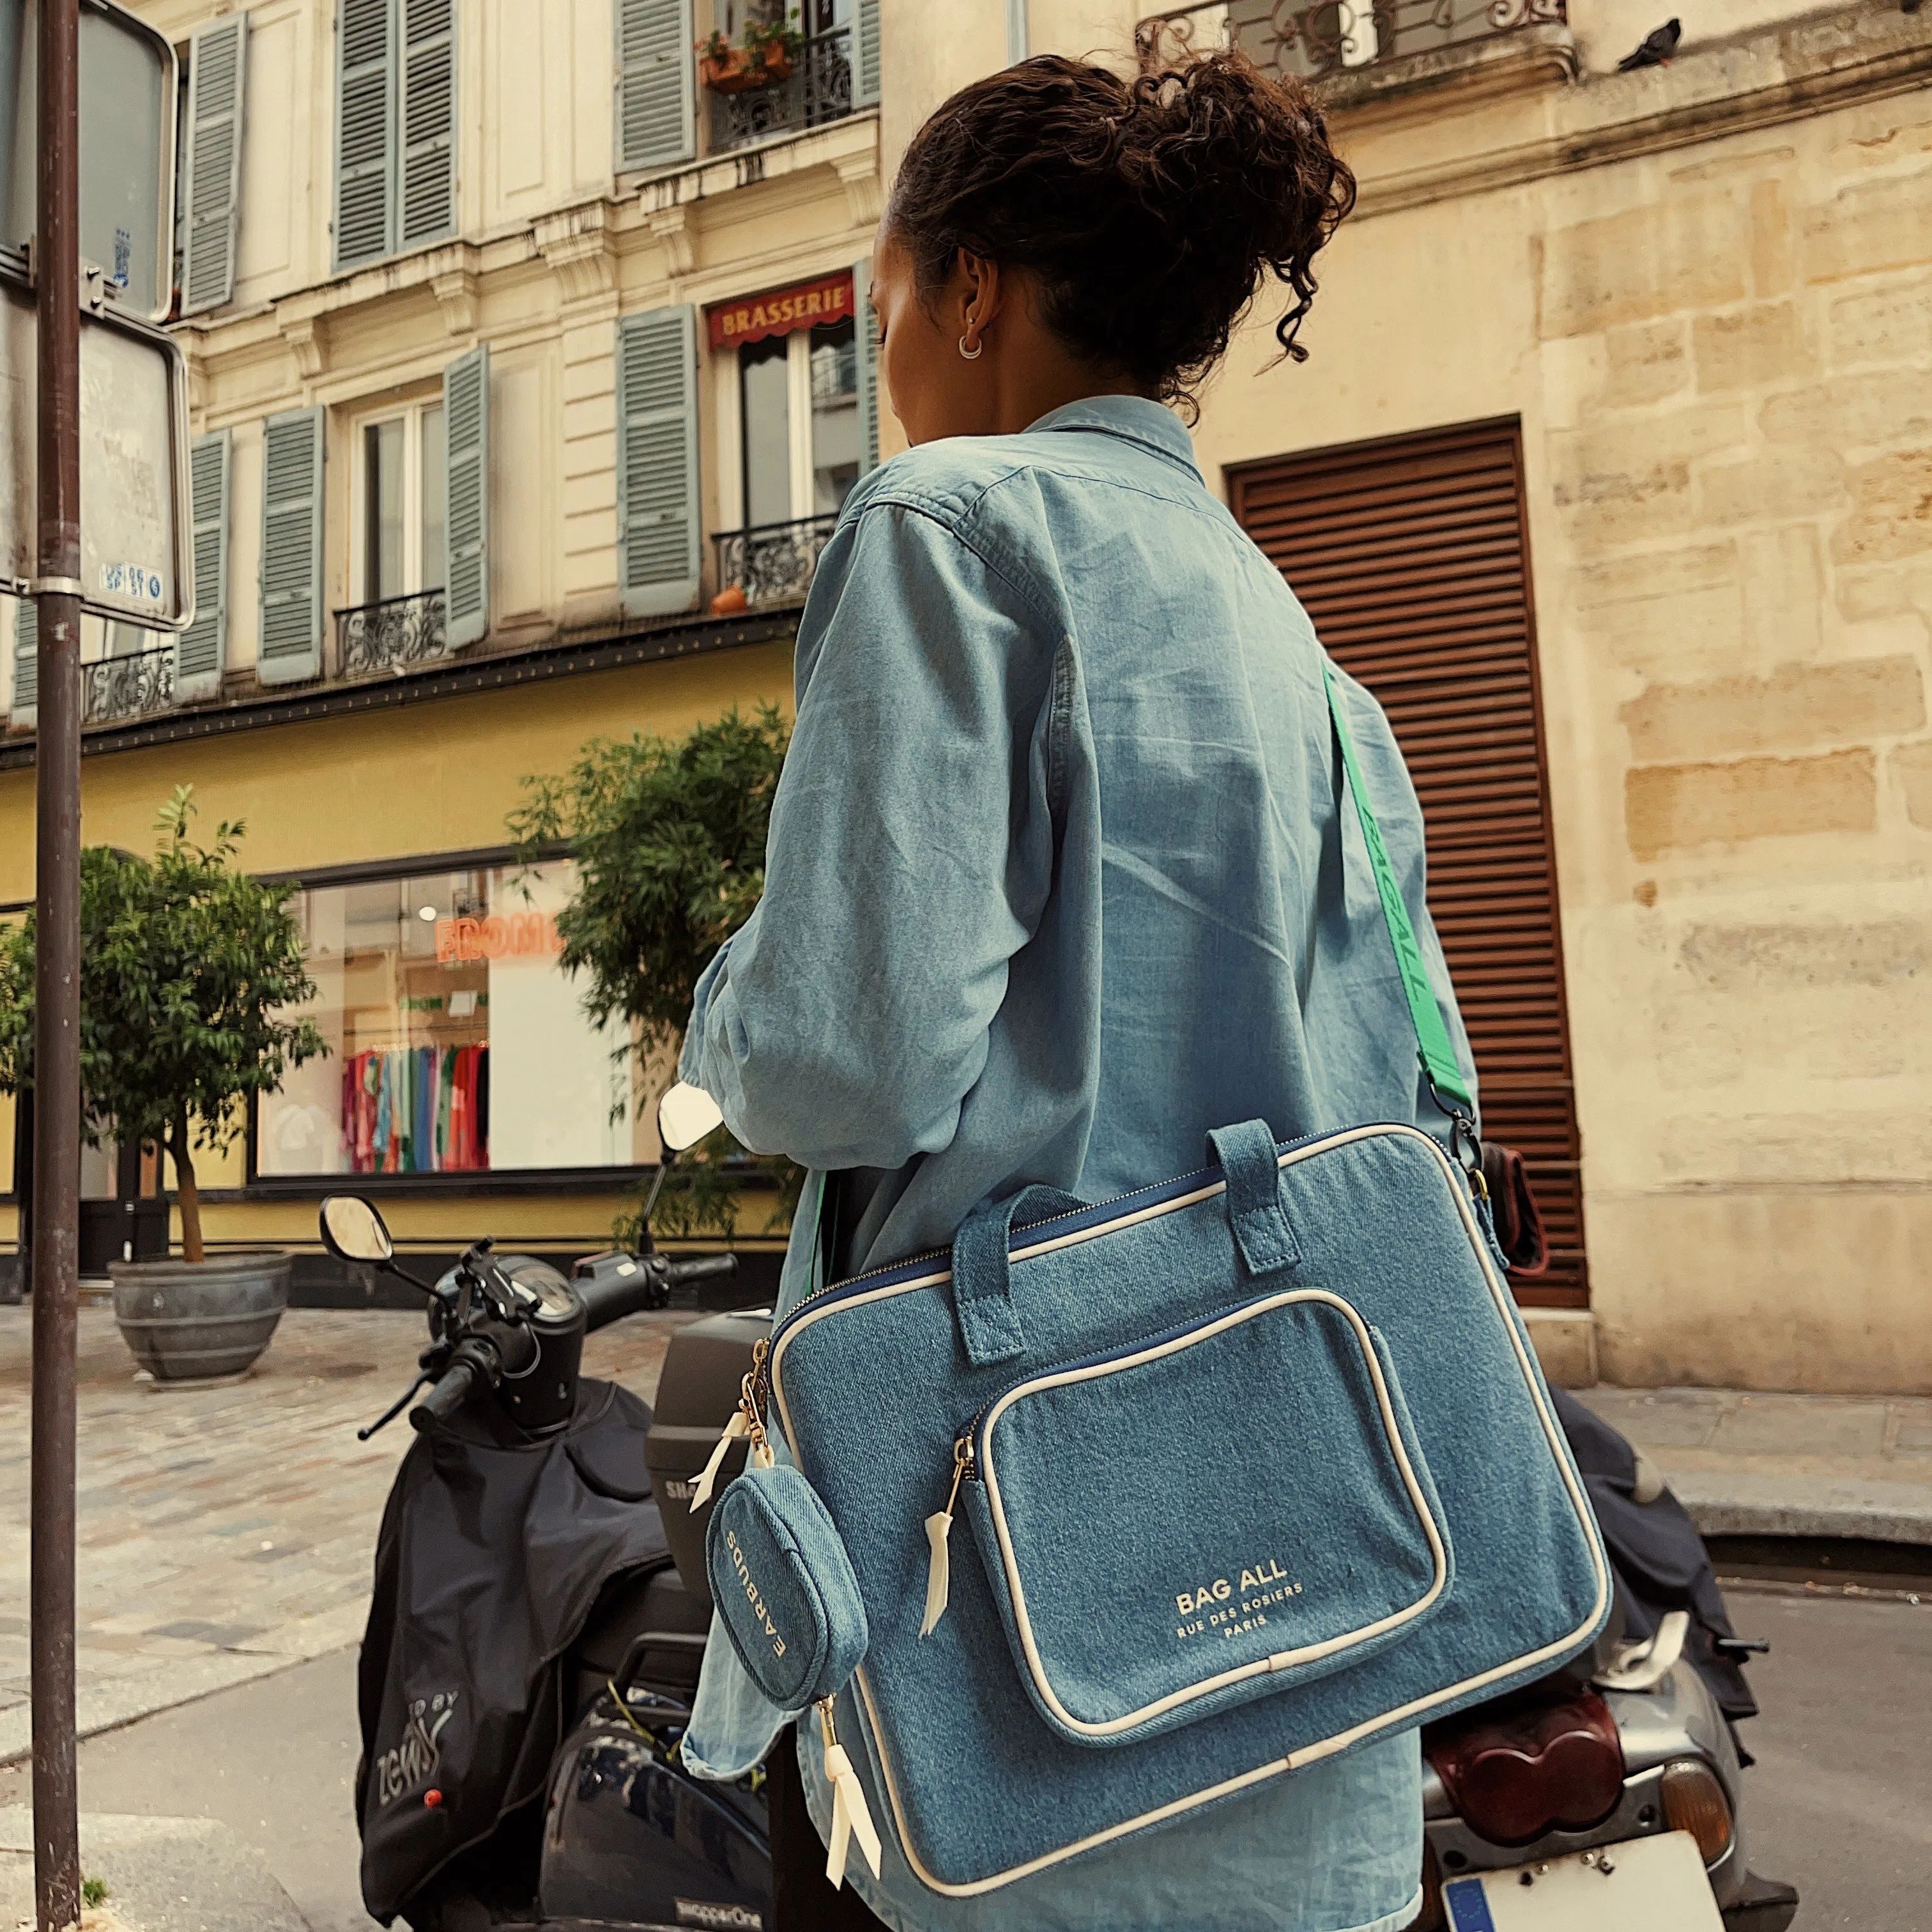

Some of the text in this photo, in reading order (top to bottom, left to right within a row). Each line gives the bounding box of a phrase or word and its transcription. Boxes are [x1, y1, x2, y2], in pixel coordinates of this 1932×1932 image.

[722, 286, 846, 336] BRASSERIE
[726, 1530, 787, 1658] EARBUDS
[1176, 1559, 1288, 1616] BAG ALL
[1177, 1583, 1303, 1639] RUE DES ROSIERS
[1223, 1614, 1268, 1639] PARIS
